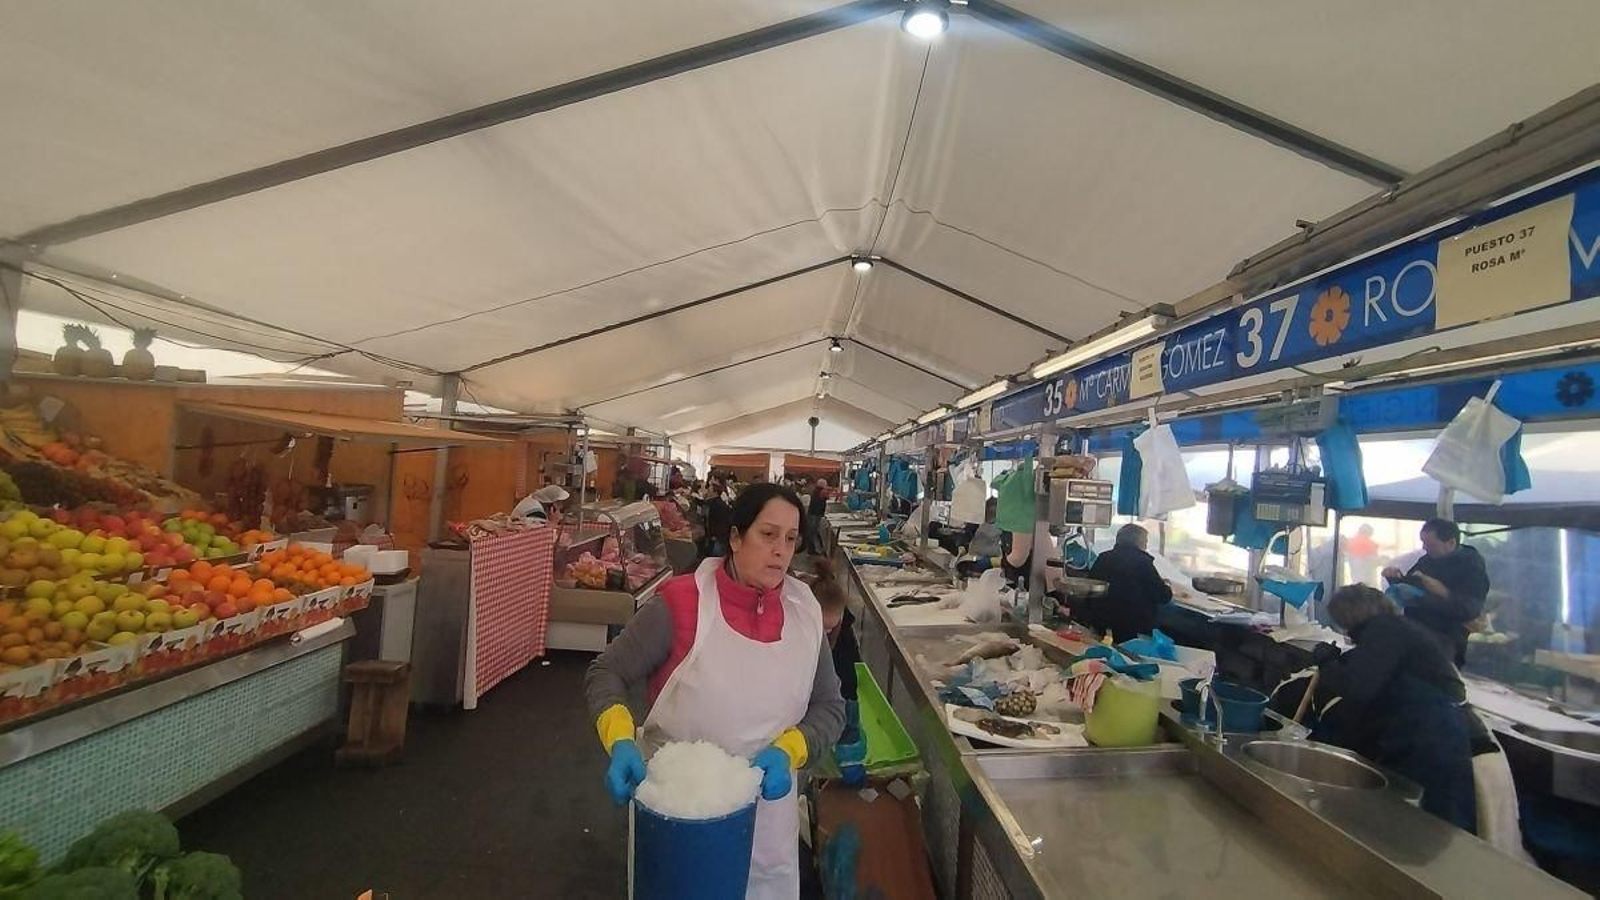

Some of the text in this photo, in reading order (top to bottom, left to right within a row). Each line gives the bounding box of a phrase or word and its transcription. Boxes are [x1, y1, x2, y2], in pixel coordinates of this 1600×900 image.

[1464, 225, 1536, 257] PUESTO 37
[1471, 255, 1506, 273] ROSA
[1236, 259, 1438, 369] 37 RO
[1043, 379, 1064, 417] 35
[1095, 360, 1132, 399] CARM
